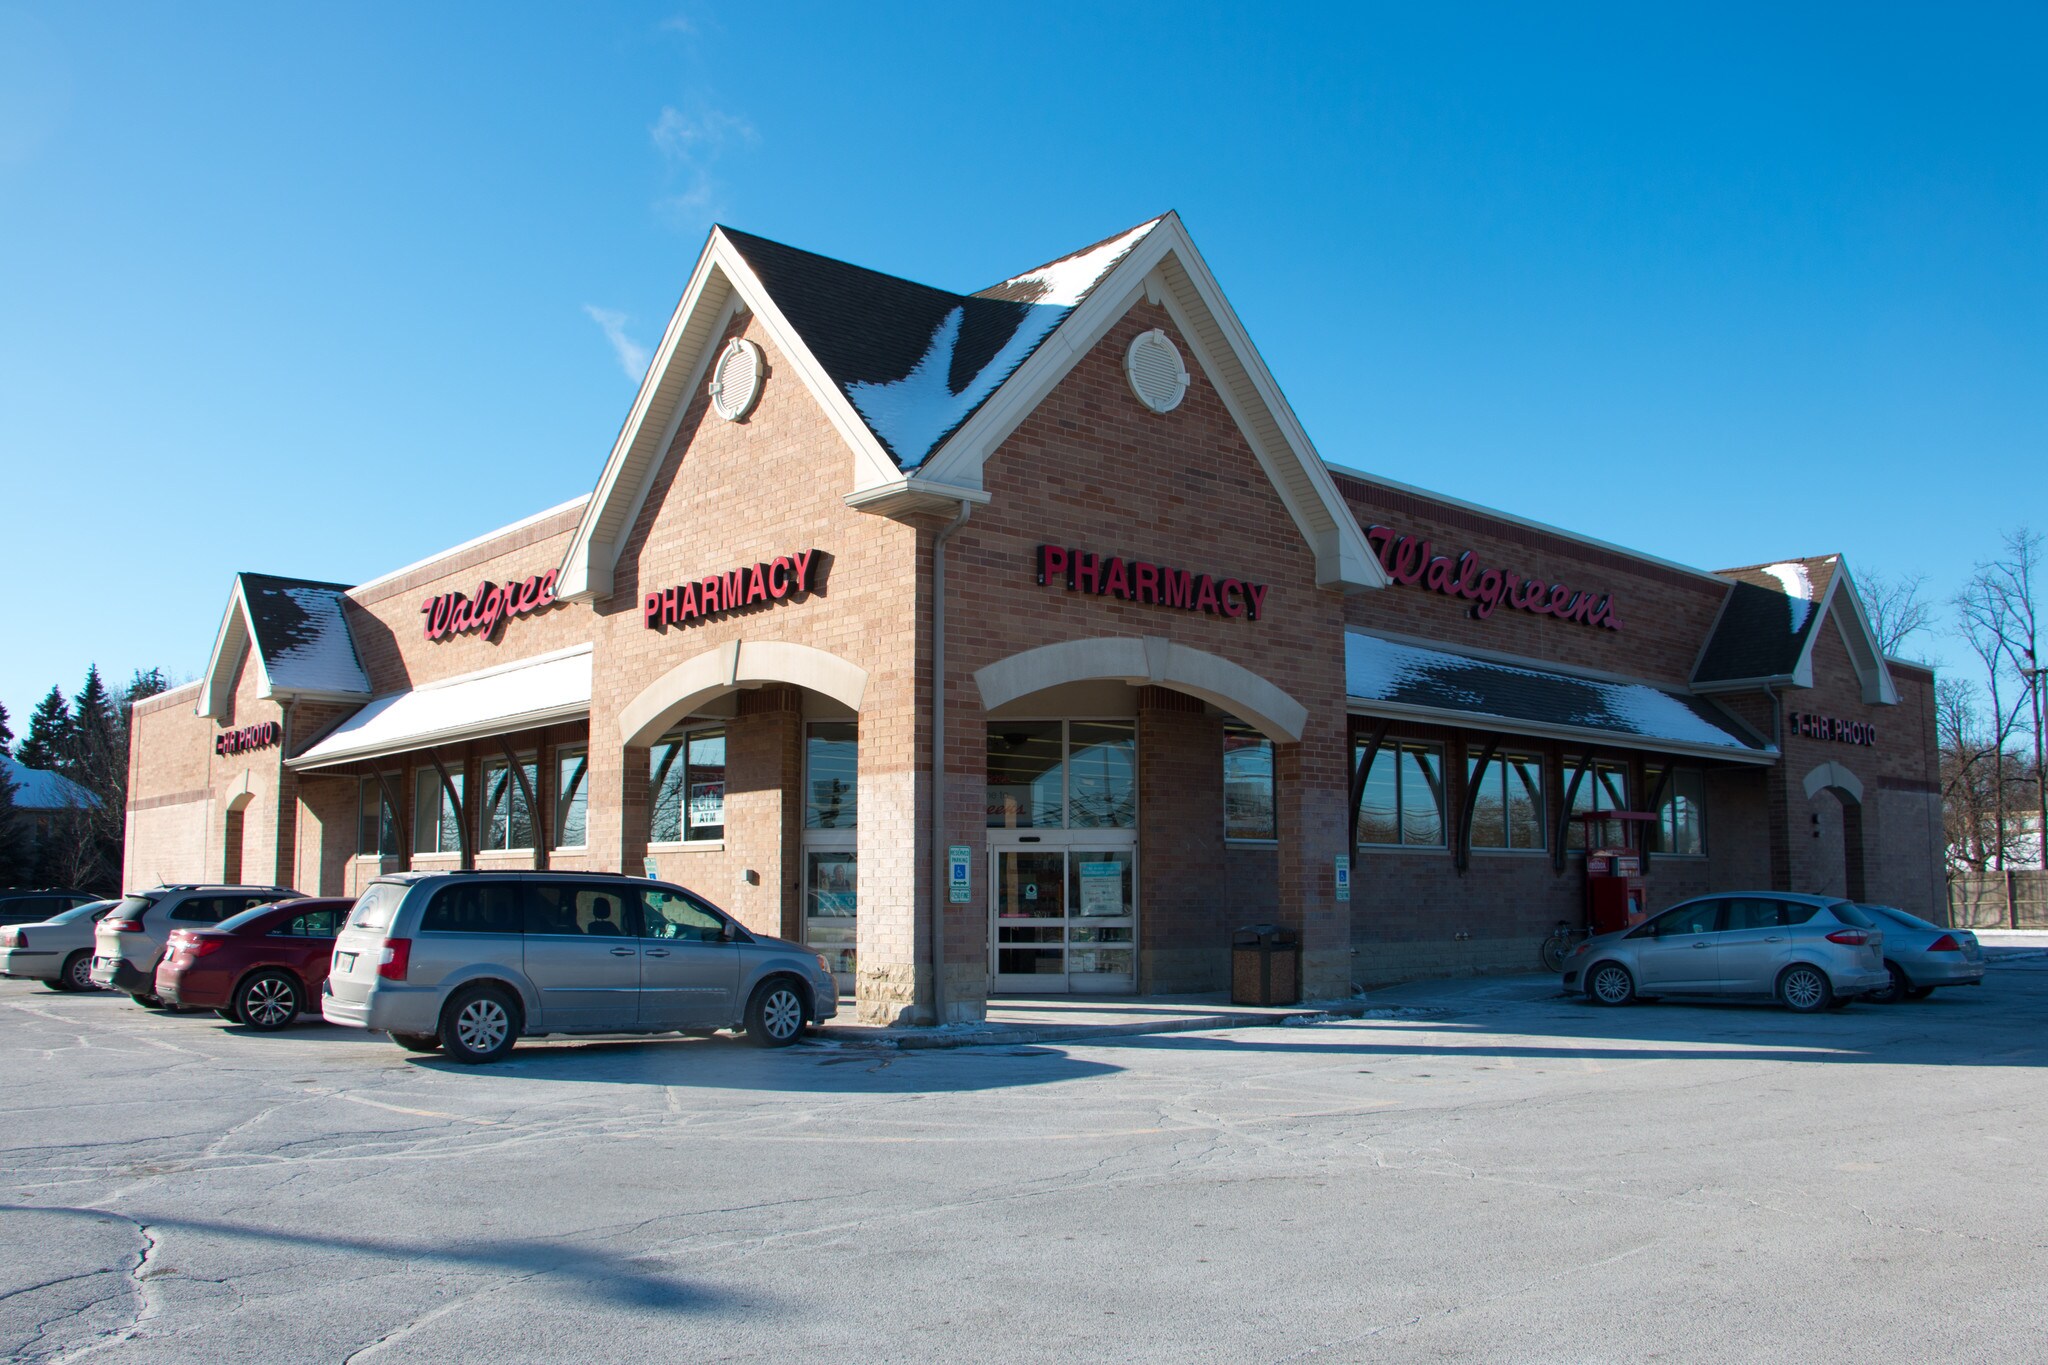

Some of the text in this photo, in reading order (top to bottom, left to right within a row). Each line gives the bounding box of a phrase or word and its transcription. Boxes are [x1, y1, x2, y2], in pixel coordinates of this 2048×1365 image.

[420, 568, 558, 640] Walgree
[644, 548, 818, 629] PHARMACY
[1038, 545, 1268, 620] PHARMACY
[1366, 525, 1625, 631] Walgreens
[238, 721, 273, 750] PHOTO
[1834, 719, 1876, 746] PHOTO
[699, 812, 716, 823] ATM
